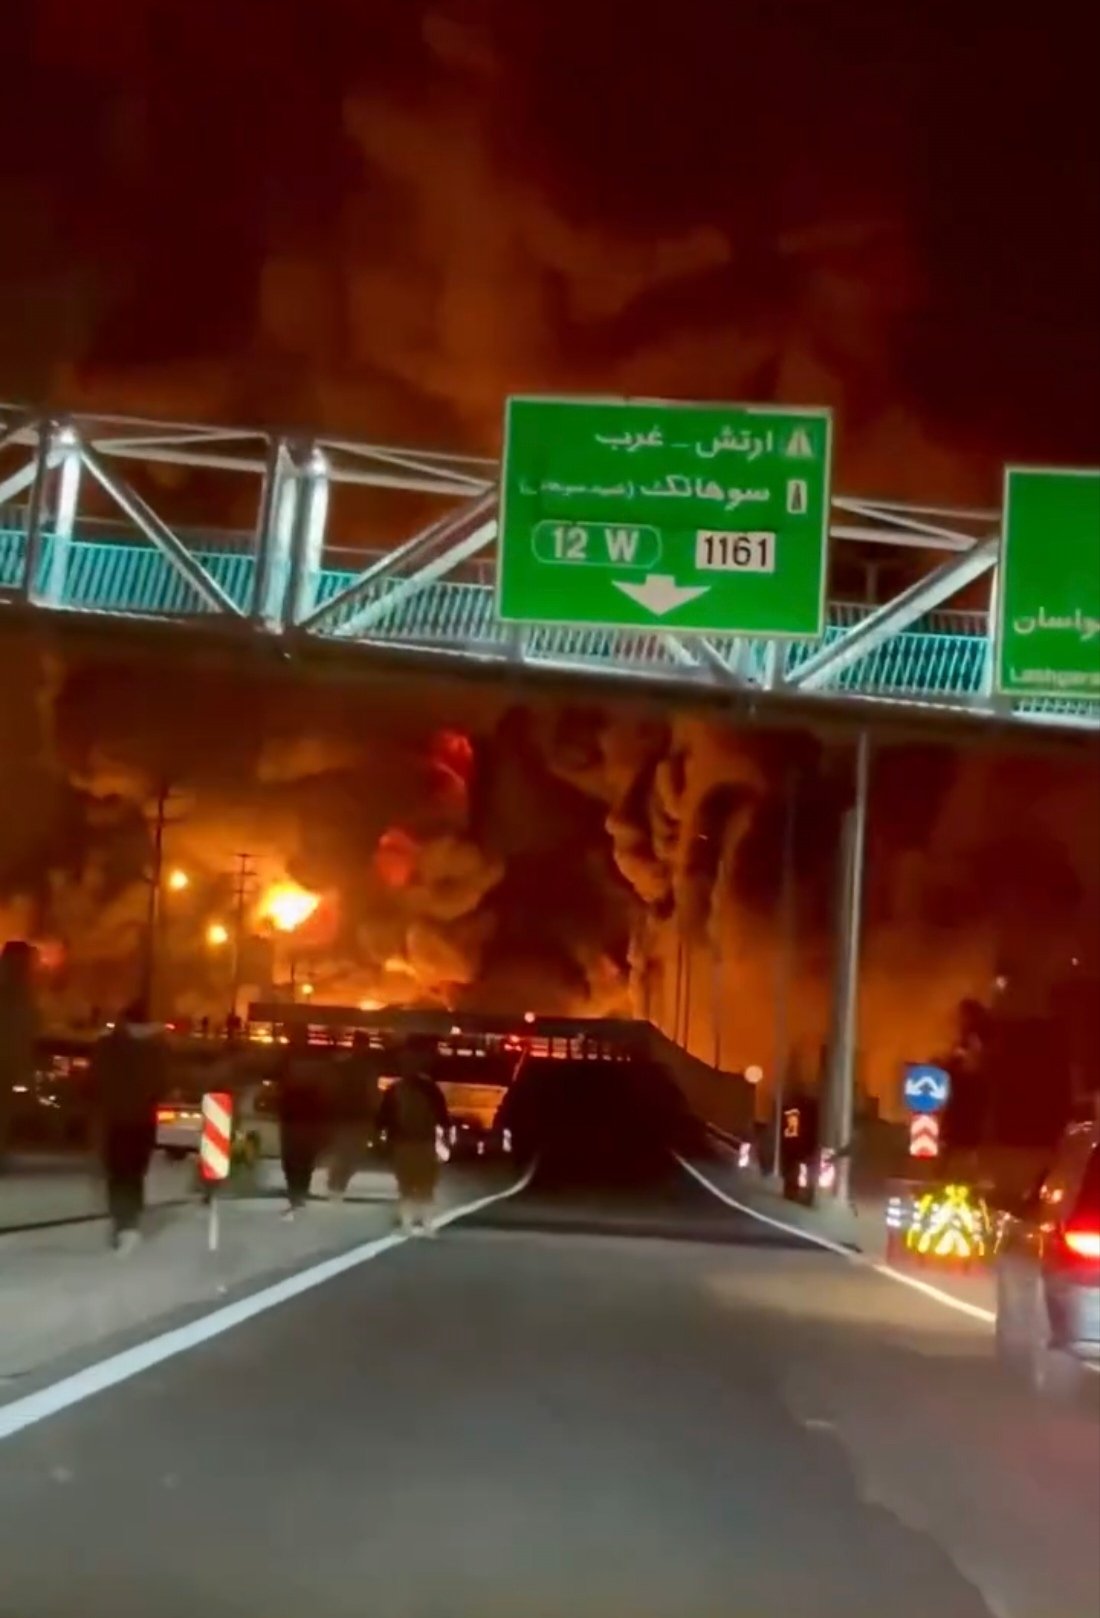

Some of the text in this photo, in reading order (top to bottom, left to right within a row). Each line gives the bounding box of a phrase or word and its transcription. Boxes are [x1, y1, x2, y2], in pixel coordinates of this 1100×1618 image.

[595, 426, 663, 452] غرب
[695, 427, 773, 460] ارتش
[551, 526, 640, 562] 12 W
[704, 535, 769, 567] 1161
[1013, 606, 1100, 641] واسان
